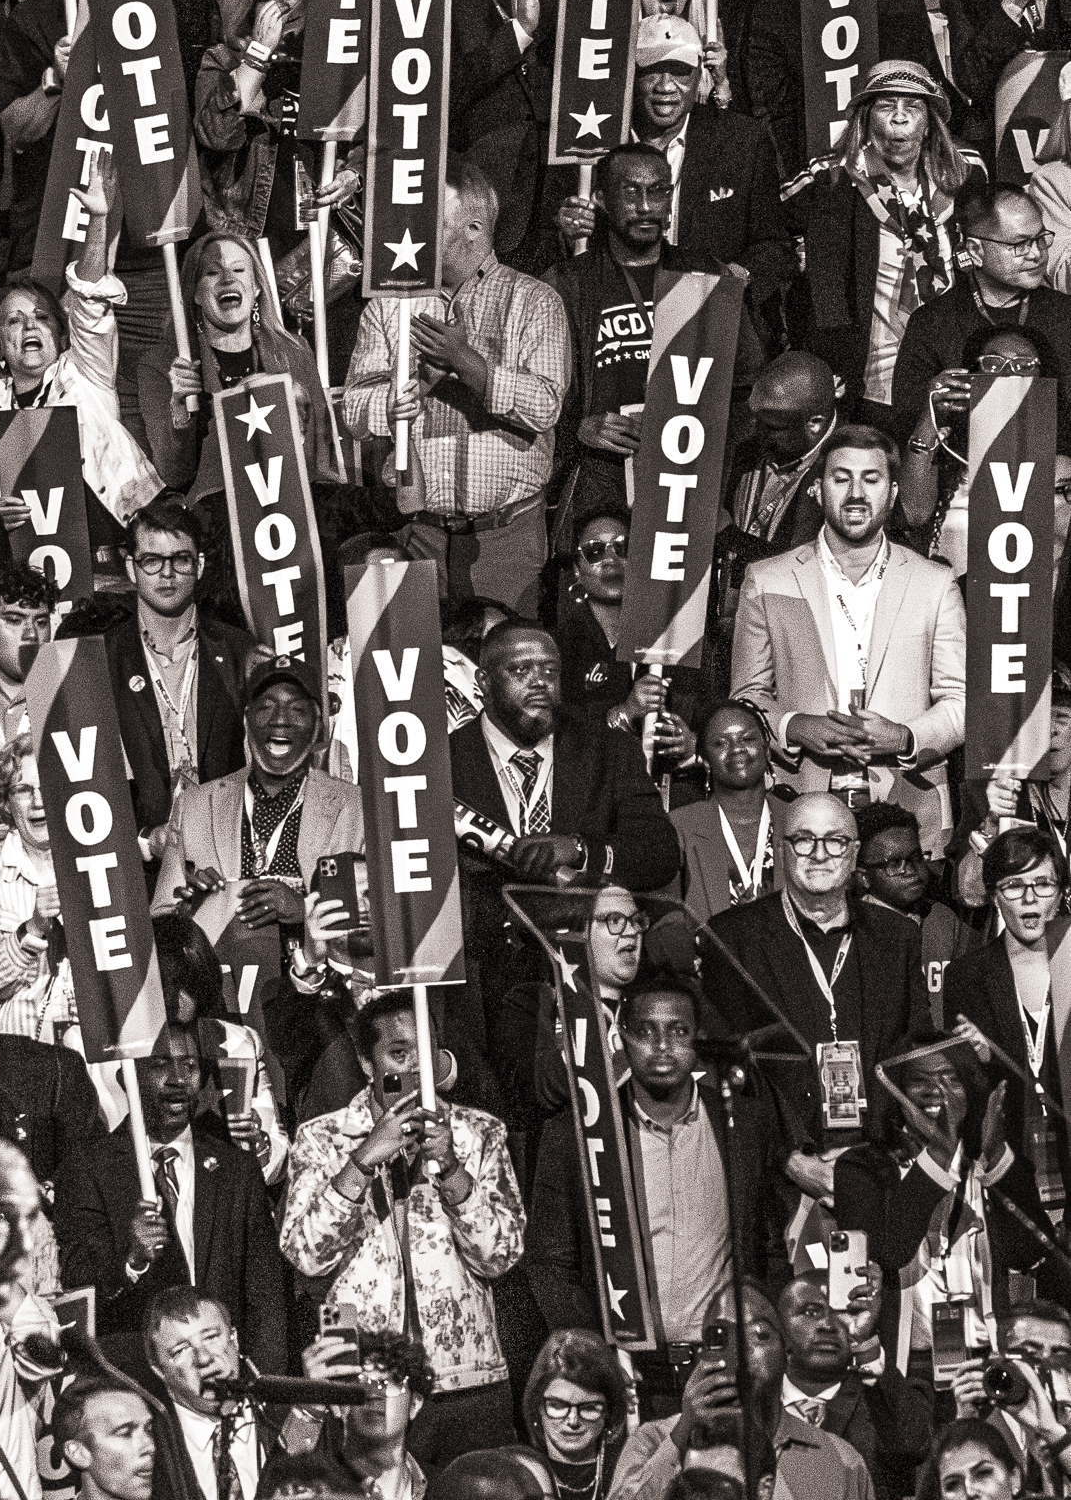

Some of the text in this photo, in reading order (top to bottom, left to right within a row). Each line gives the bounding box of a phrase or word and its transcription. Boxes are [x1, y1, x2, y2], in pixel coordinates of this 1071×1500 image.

[651, 355, 714, 581] VOTE
[988, 462, 1034, 694] VOTE
[50, 725, 133, 971] VOTE
[372, 648, 432, 894] VOTE
